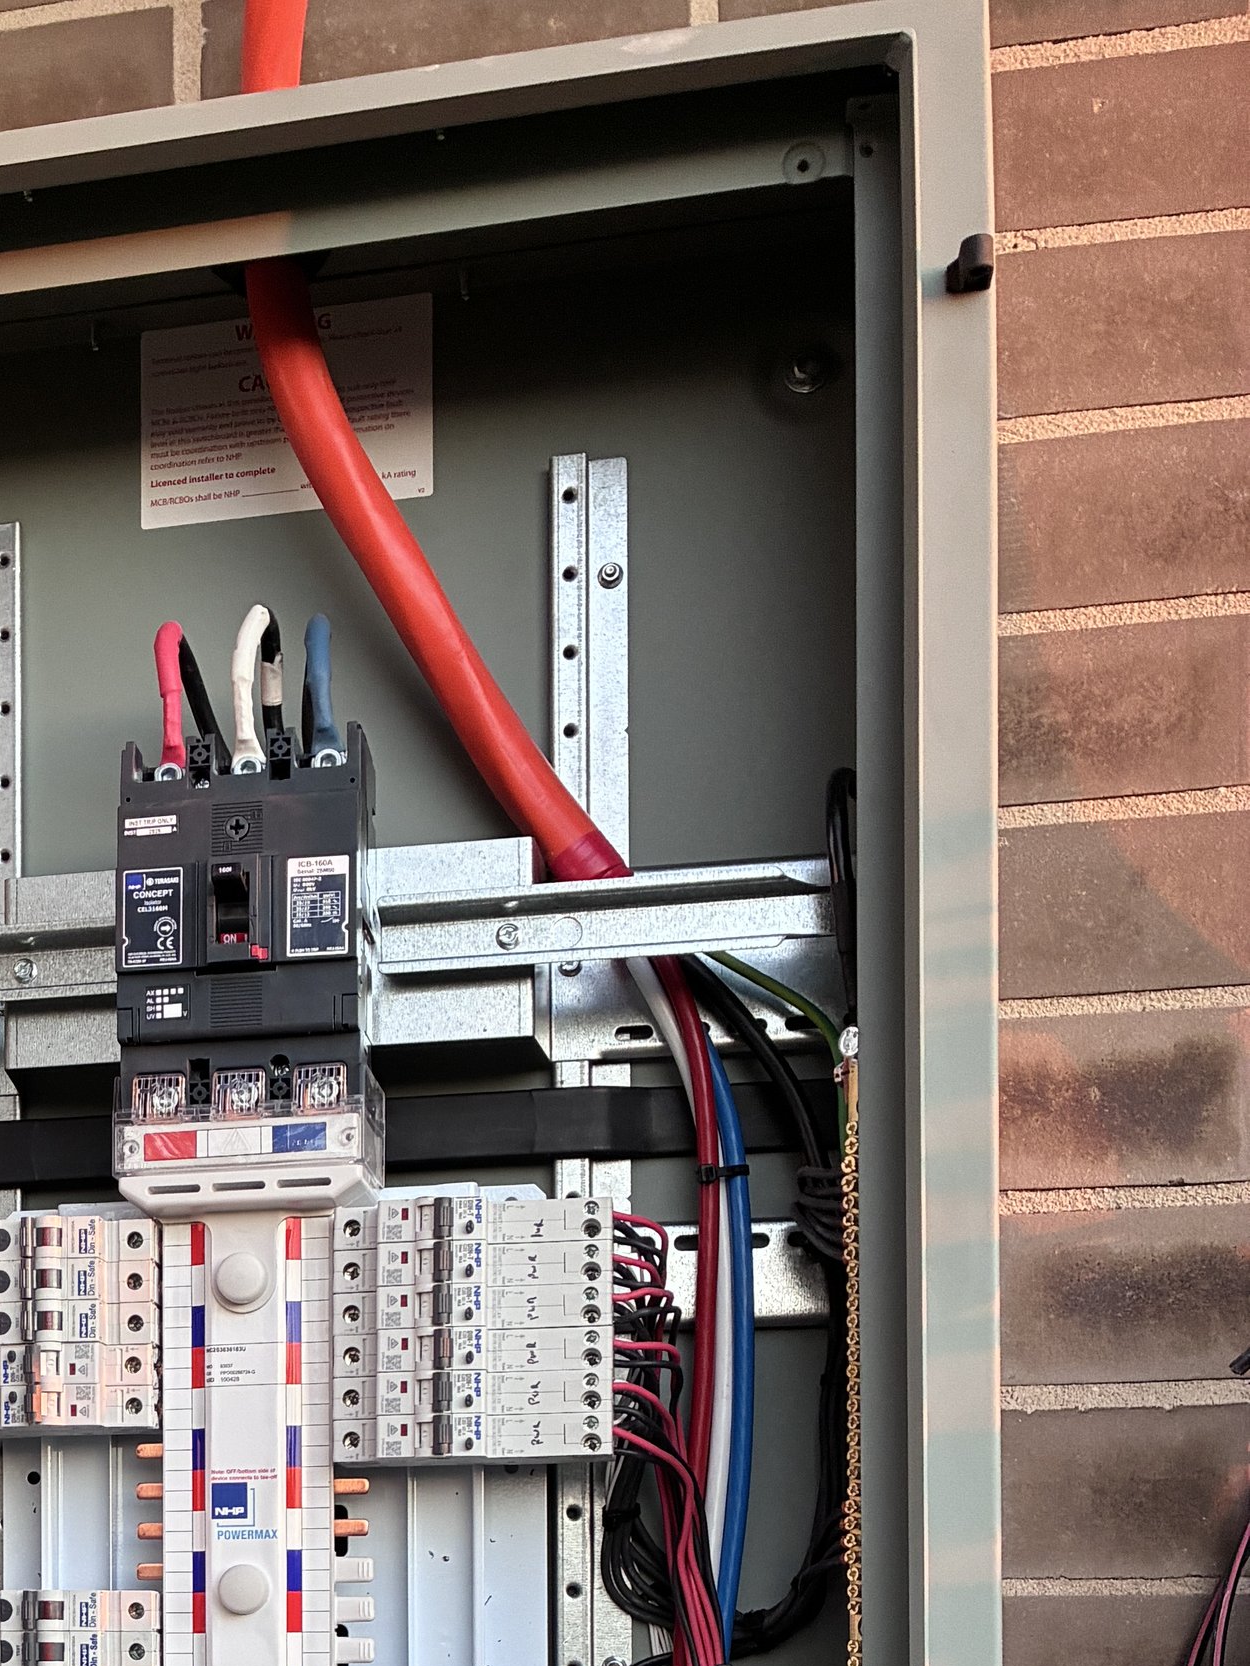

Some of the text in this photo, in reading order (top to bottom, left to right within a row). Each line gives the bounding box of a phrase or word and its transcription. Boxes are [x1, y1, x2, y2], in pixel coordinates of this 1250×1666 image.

[150, 465, 276, 488] Licenced installer to complete
[393, 468, 416, 480] rating
[195, 492, 211, 503] shall
[212, 490, 222, 500] be
[224, 488, 241, 499] NHP
[133, 889, 174, 899] CONCEPT
[215, 1507, 245, 1516] NHP
[217, 1529, 278, 1540] POWERMAX
